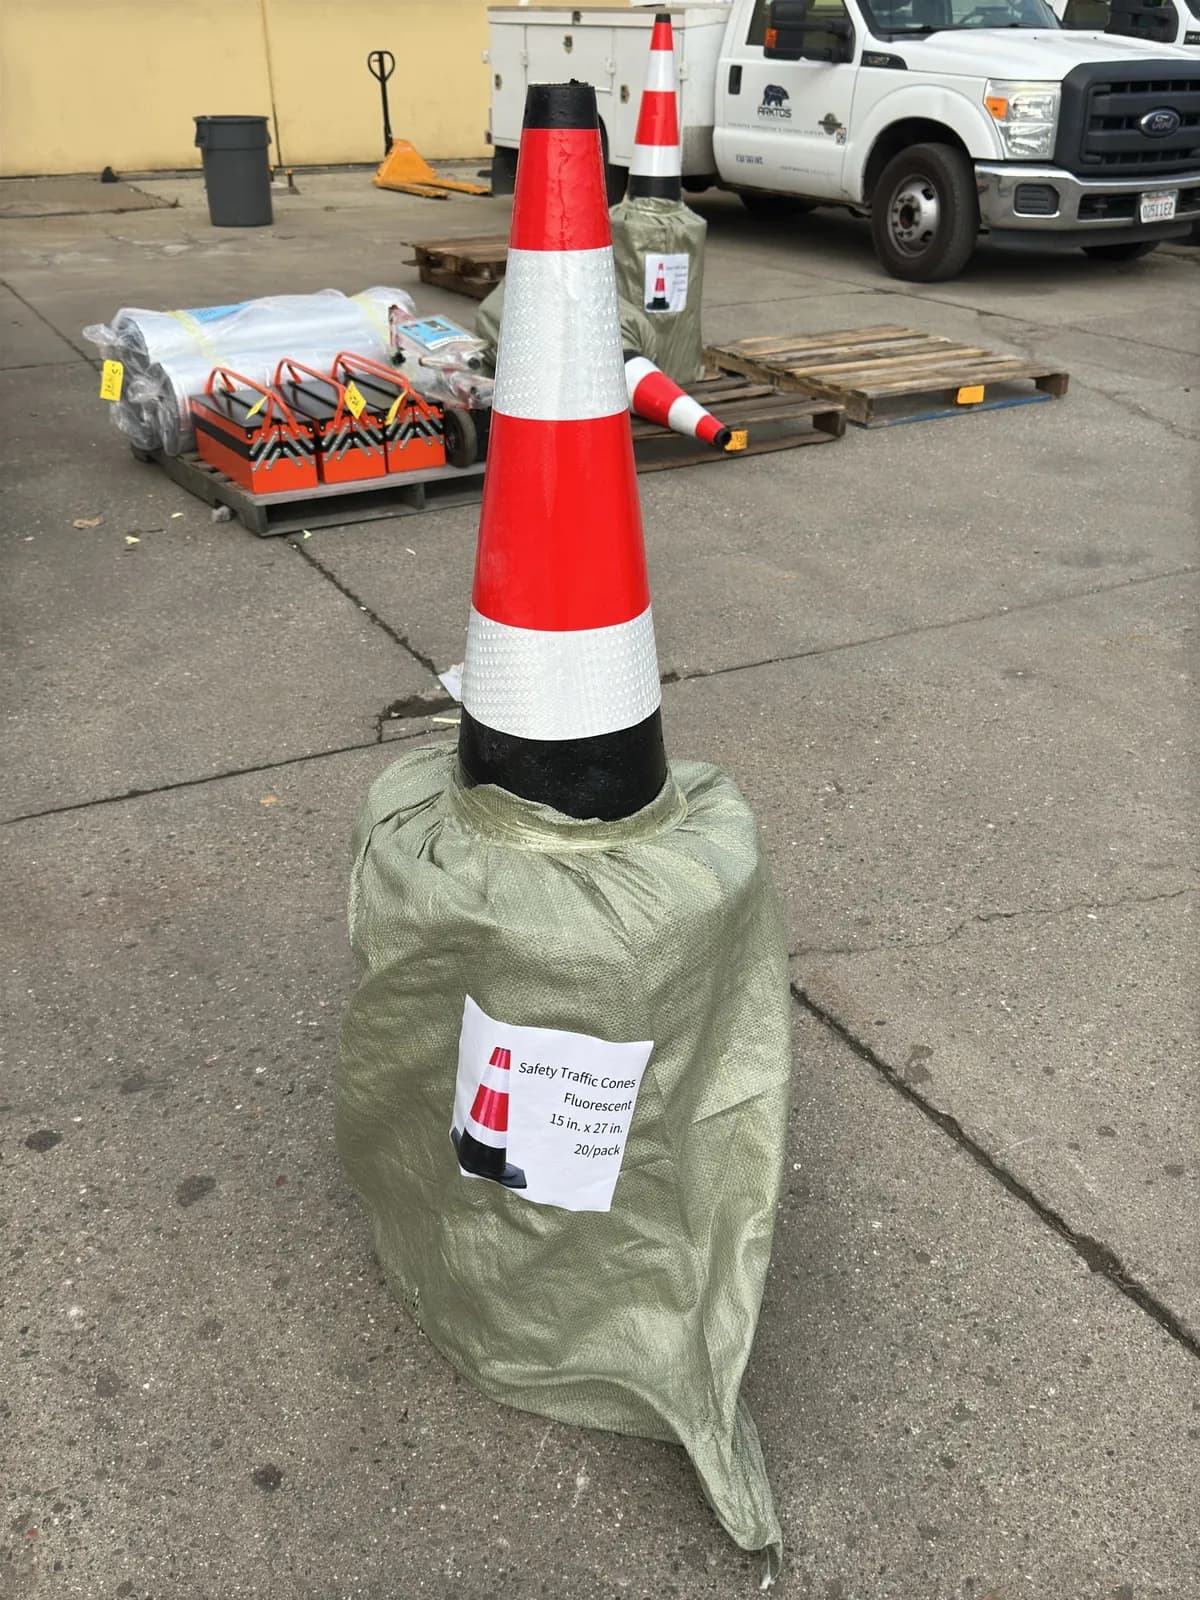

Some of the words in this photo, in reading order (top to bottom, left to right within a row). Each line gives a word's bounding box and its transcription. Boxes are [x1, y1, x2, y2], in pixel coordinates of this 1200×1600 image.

[757, 106, 792, 118] ARKTOS
[1151, 114, 1174, 129] Ford
[518, 1062, 558, 1080] Safety
[560, 1067, 598, 1088] Traffic
[601, 1077, 636, 1090] Cones
[564, 1092, 632, 1112] Fluorescent
[550, 1113, 565, 1127] 15
[566, 1115, 581, 1132] in.
[583, 1124, 591, 1133] x
[593, 1122, 608, 1134] 27
[609, 1122, 623, 1134] in.
[574, 1143, 621, 1158] 20/pack
